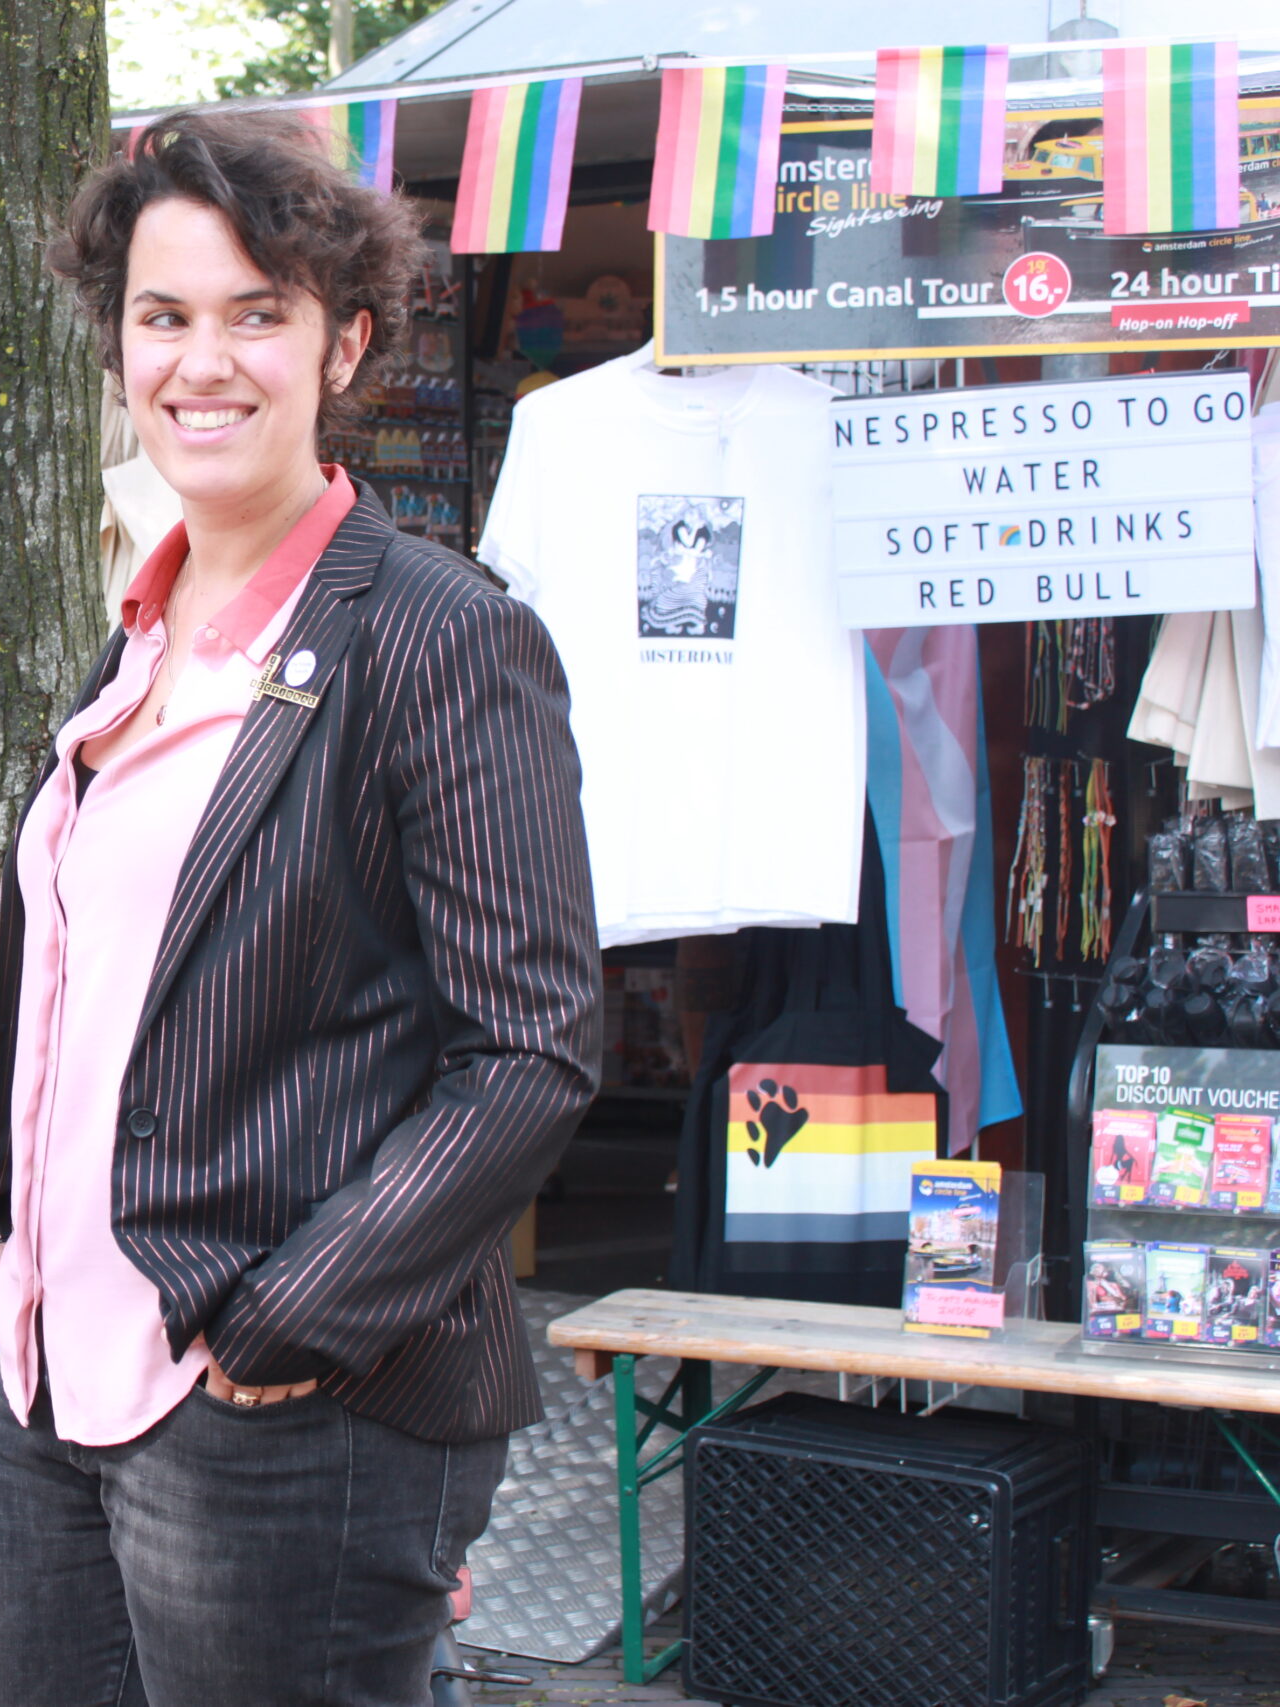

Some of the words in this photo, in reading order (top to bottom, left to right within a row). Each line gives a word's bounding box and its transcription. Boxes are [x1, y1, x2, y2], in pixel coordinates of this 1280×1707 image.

[780, 155, 872, 183] mster
[775, 184, 841, 213] ircle
[805, 199, 944, 238] Sightseeing
[1154, 240, 1207, 252] amsterdam
[1208, 236, 1233, 247] circle
[695, 286, 738, 317] 1,5
[747, 283, 818, 312] hour
[826, 278, 914, 309] Canal
[922, 278, 994, 305] Tour
[1110, 270, 1150, 298] 24
[1161, 267, 1239, 297] hour
[1119, 316, 1173, 332] Hop-on
[1177, 312, 1239, 331] Hop-off
[835, 400, 1092, 448] NESPRESSO
[1118, 397, 1168, 428] TO
[1194, 391, 1245, 424] GO
[963, 459, 1101, 494] WATER
[886, 522, 990, 556] SOFT
[1029, 510, 1193, 549] DRINKS
[919, 578, 996, 609] RED
[1037, 570, 1141, 604] BULL
[1115, 1065, 1149, 1084] TOP
[1151, 1066, 1171, 1085] 10
[1116, 1085, 1203, 1106] DISCOUNT
